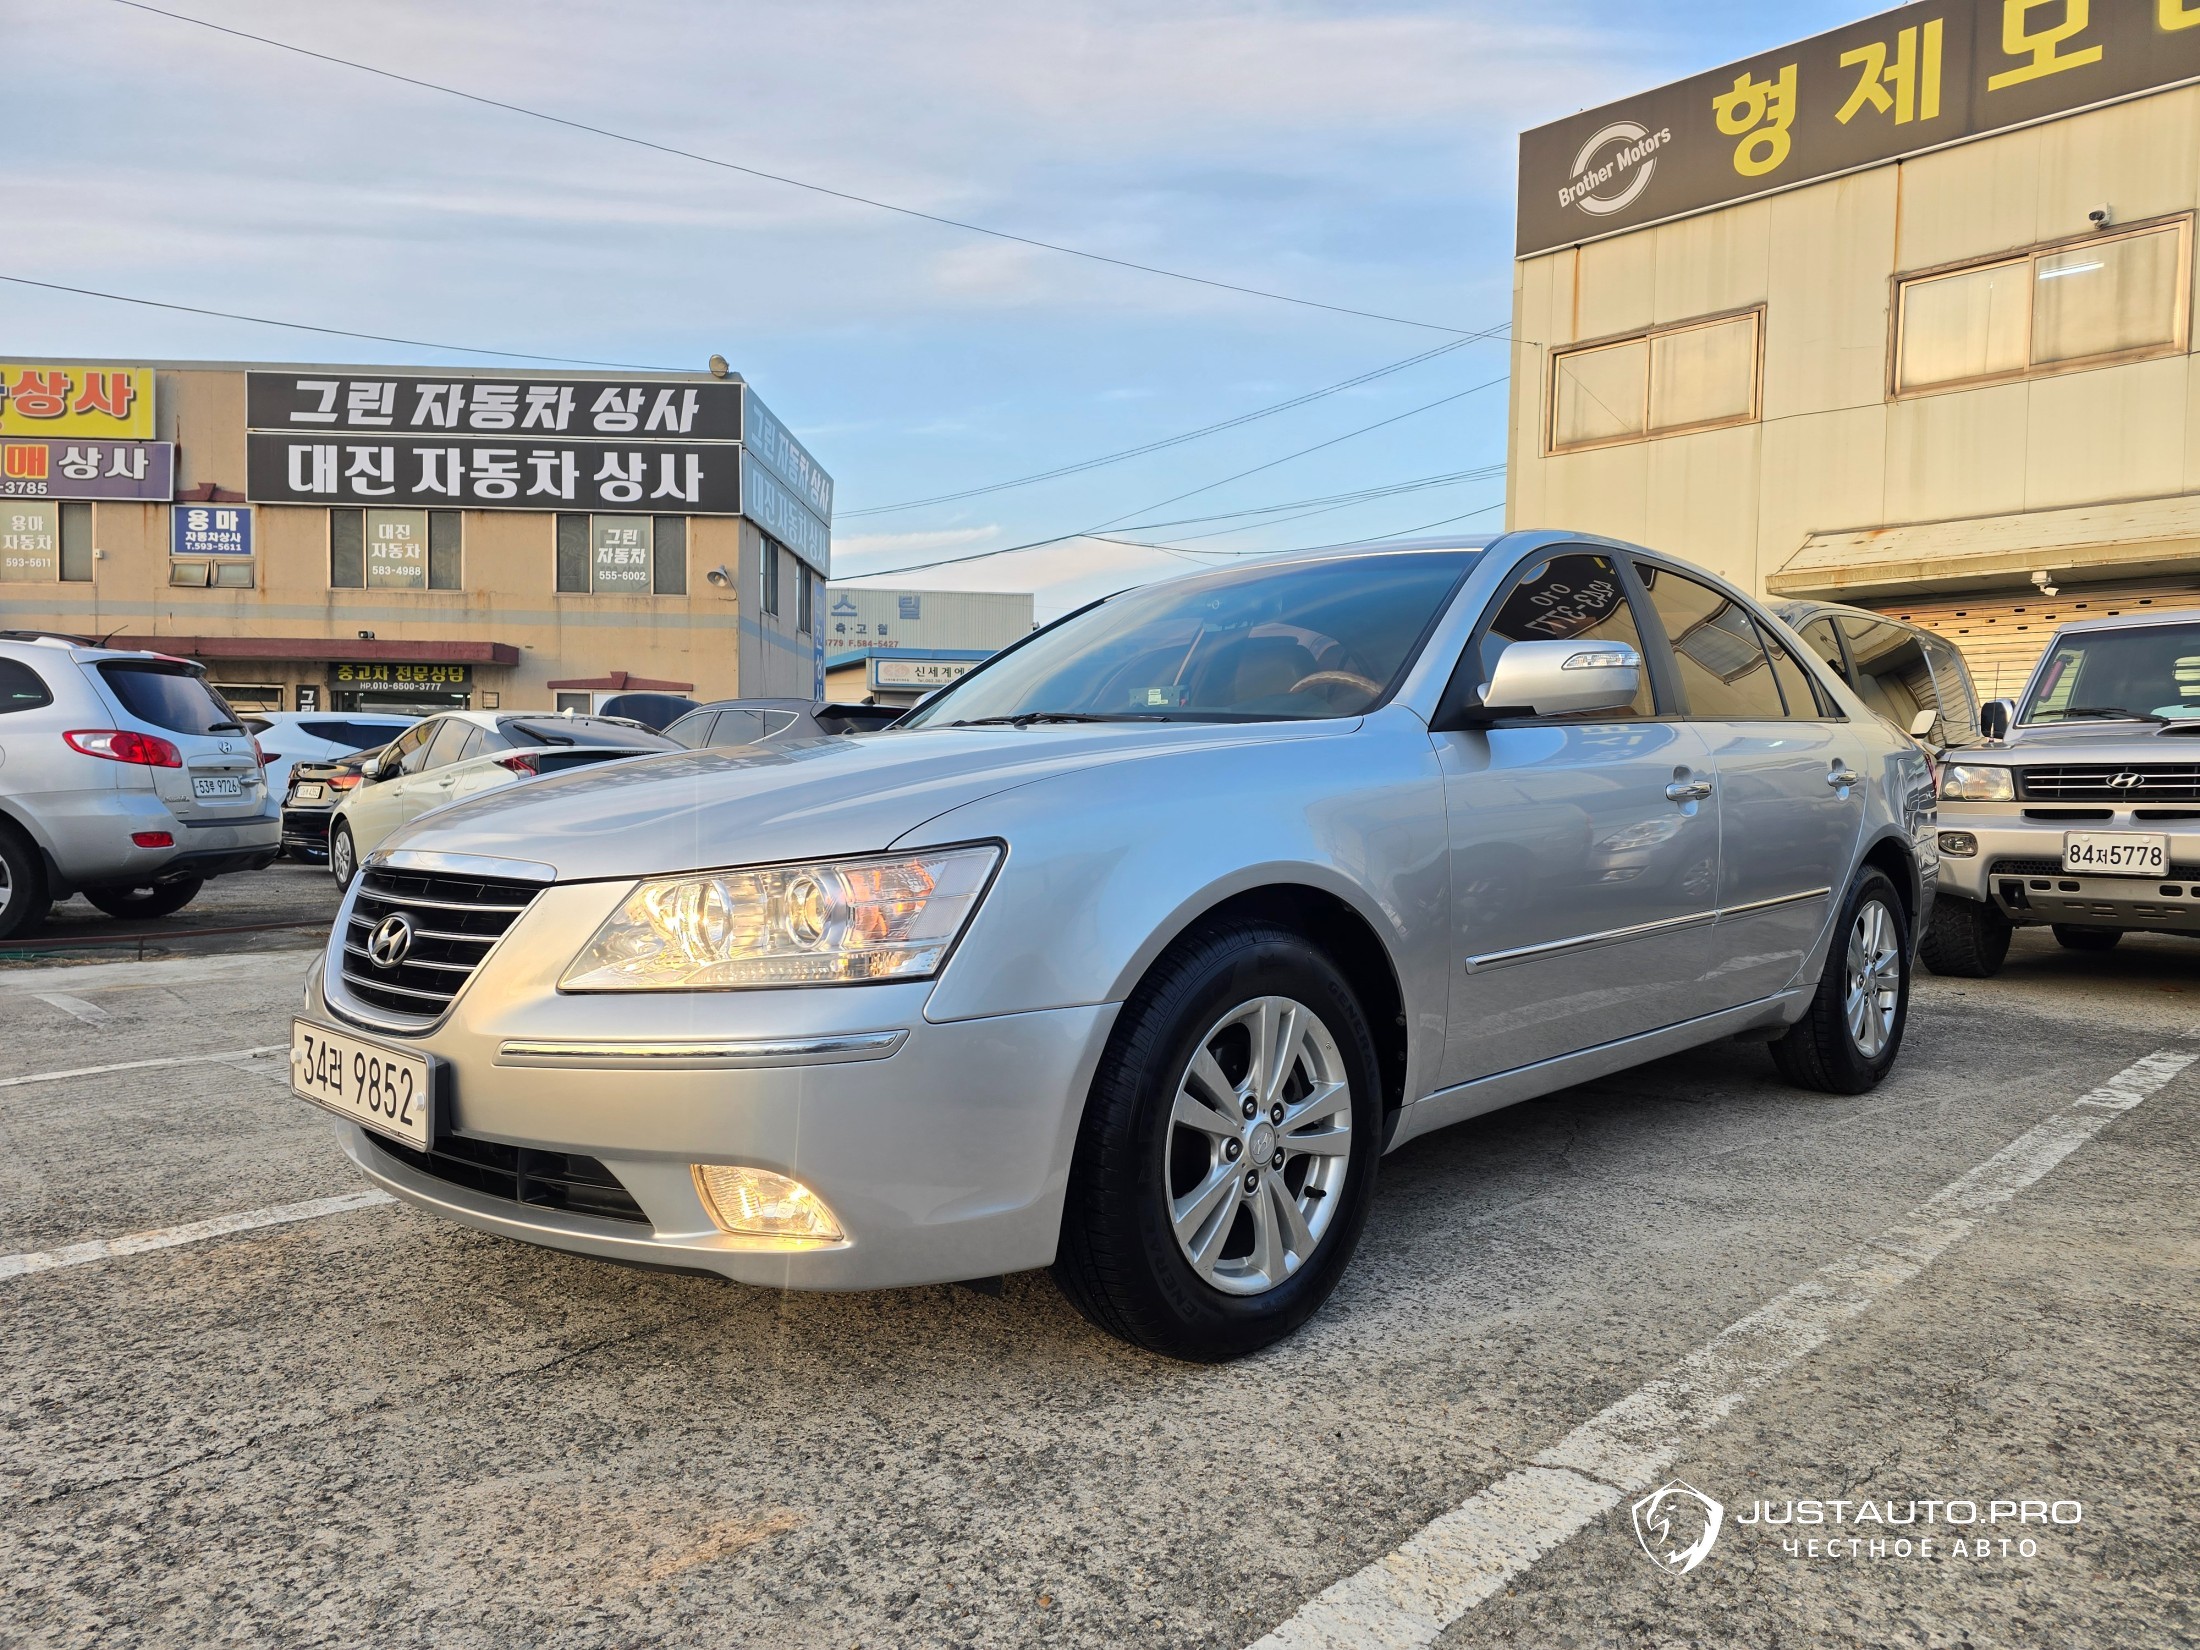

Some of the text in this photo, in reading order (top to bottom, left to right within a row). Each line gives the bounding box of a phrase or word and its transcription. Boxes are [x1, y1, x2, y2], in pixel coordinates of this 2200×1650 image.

[1558, 125, 1672, 208] Brother Motors
[289, 380, 700, 434] 그린 자동차 상사
[0, 444, 149, 480] 매 상사
[751, 403, 830, 515] 그린 자동차 상사
[287, 444, 704, 503] 대진 자동차 상사
[11, 515, 44, 531] 용마
[187, 509, 239, 532] 용마
[752, 467, 827, 569] 대진 자동차 상사
[185, 532, 242, 543] 자동차상사
[378, 524, 411, 540] 대진
[605, 529, 638, 546] 그린
[3, 534, 53, 550] 자동차
[185, 542, 242, 551] T.593-5611
[371, 542, 421, 559] 자동차
[6, 557, 51, 568] 593-5611
[597, 548, 646, 565] 자동차
[372, 565, 421, 576] 583-4988
[599, 571, 646, 581] 555-6002
[826, 639, 899, 648] 779 F.584-5427
[337, 664, 465, 683] 중고차 전문상담
[360, 682, 442, 691] HP.010-6500-3777
[199, 779, 237, 794] 53루 9726
[2069, 843, 2162, 867] 84저5778
[303, 1034, 413, 1127] 34러 9852
